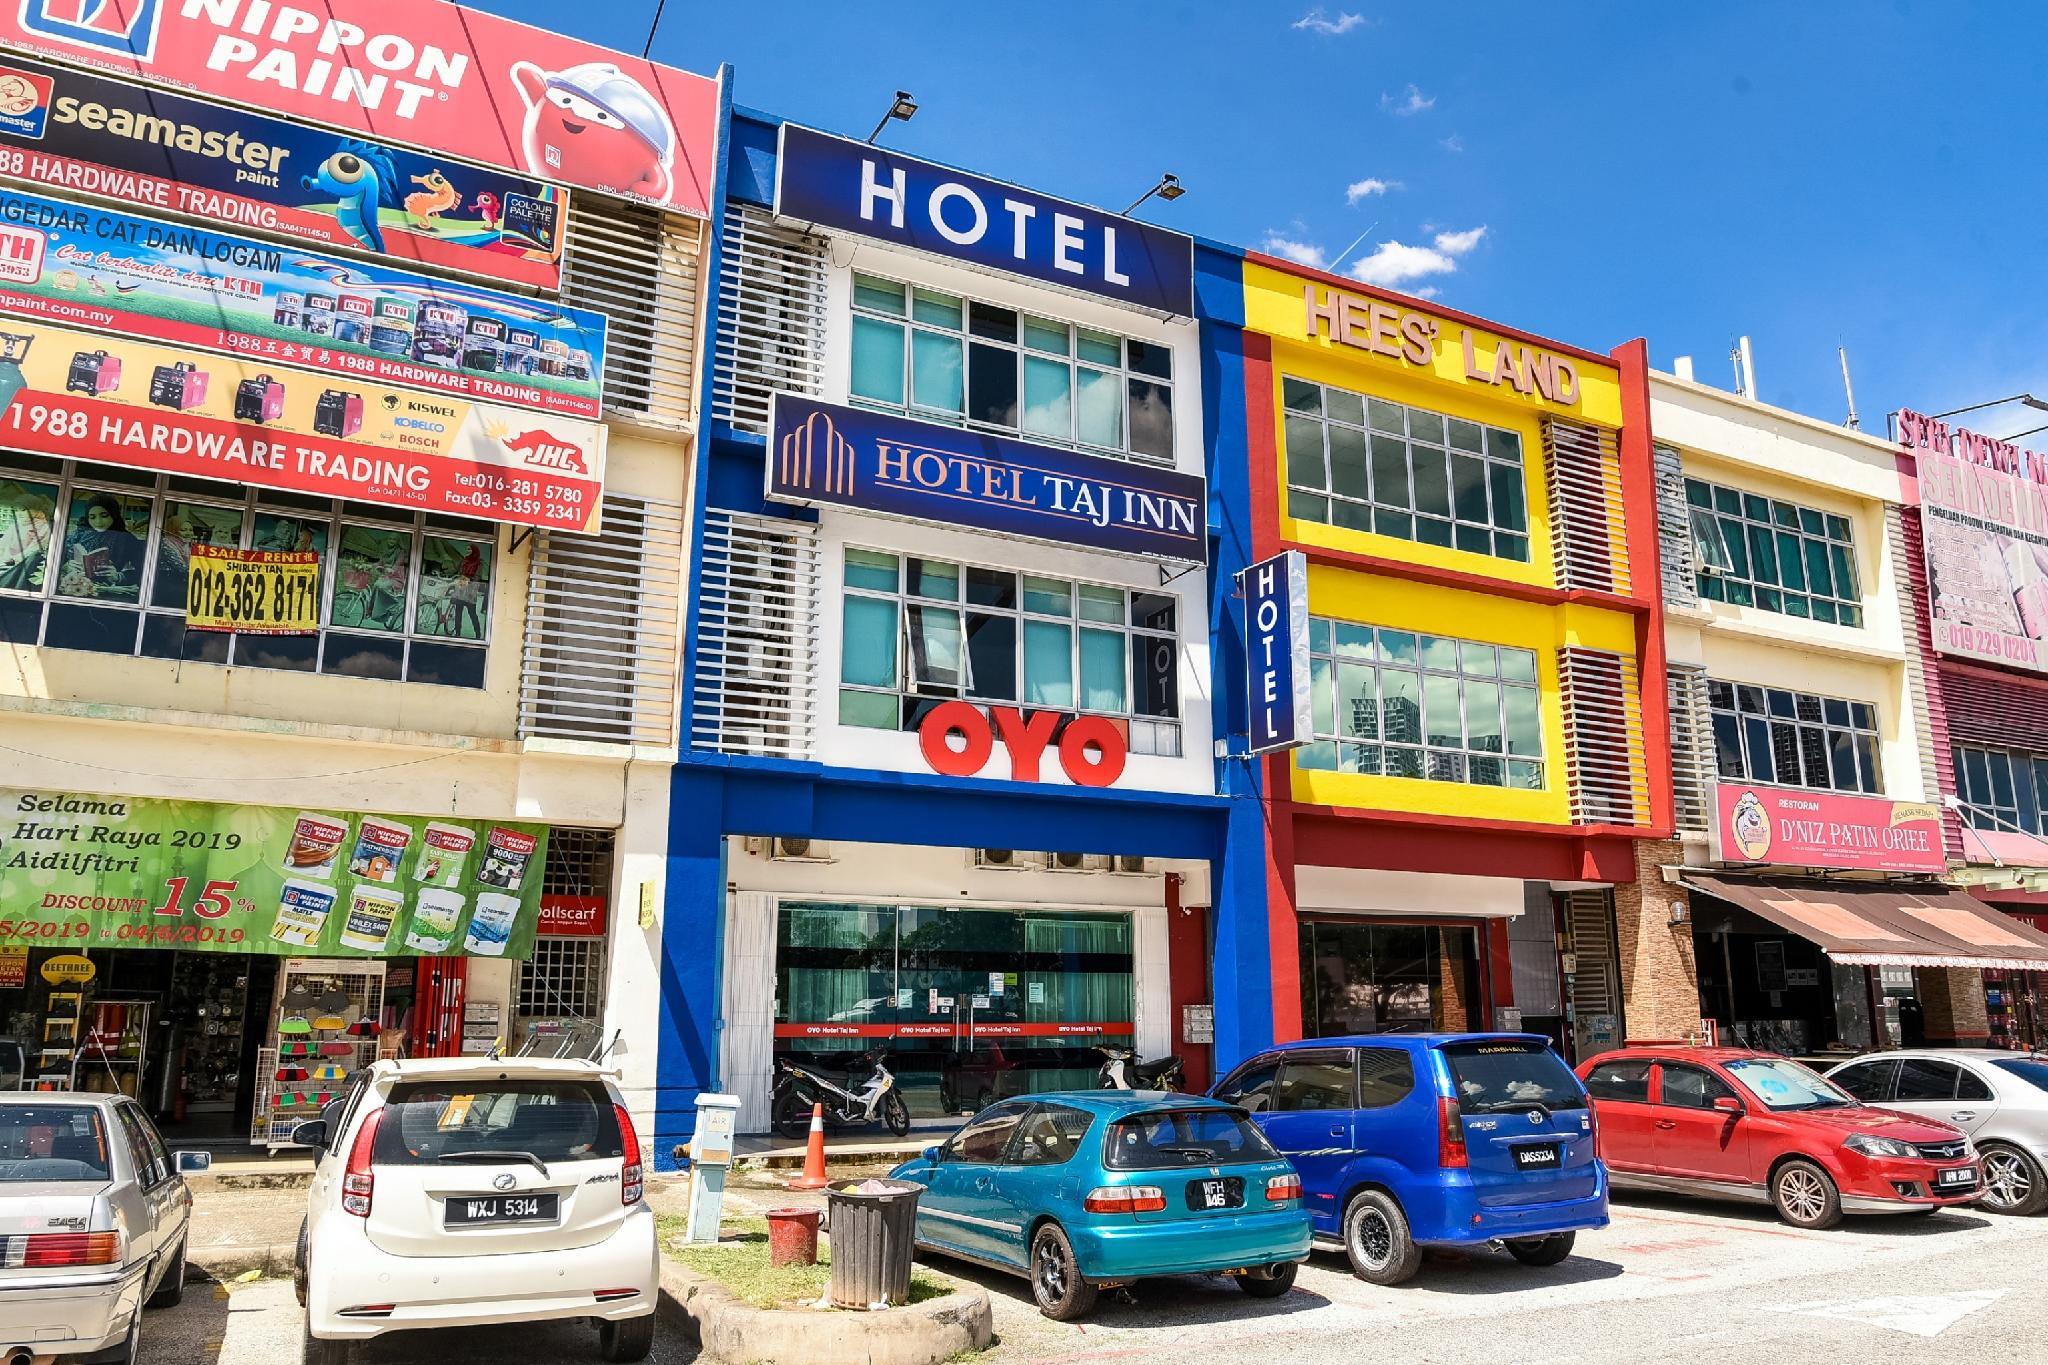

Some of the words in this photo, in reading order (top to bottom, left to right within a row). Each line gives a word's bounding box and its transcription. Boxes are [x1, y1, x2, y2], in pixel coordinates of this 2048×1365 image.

[181, 0, 469, 88] NIPPON
[36, 45, 90, 65] HARDWARE
[92, 58, 134, 75] TRADING
[206, 34, 434, 119] PAINT
[53, 96, 290, 173] seamaster
[31, 155, 171, 206] HARDWARE
[177, 187, 277, 228] TRADING
[235, 169, 279, 189] paint
[509, 206, 552, 223] PALETTE
[510, 199, 552, 214] COLOUR
[0, 196, 89, 235] GEDAR
[96, 217, 142, 244] CAT
[146, 226, 195, 256] DAN
[201, 238, 282, 273] LOGAM
[859, 159, 1131, 287] HOTEL
[56, 244, 93, 261] Cat
[223, 276, 262, 296] KTH
[338, 355, 375, 373] 1988
[380, 363, 468, 390] HARDWARE
[474, 380, 541, 403] TRADING
[1461, 329, 1581, 407] LAND
[408, 401, 457, 418] KISWEL
[393, 416, 445, 433] KOBELCO
[1899, 408, 1953, 457] SERI
[10, 402, 88, 439] 1988
[100, 415, 287, 470] HARDWARE
[295, 447, 431, 492] TRADING
[400, 433, 440, 449] BOSCH
[454, 472, 539, 497] Tel:016-281
[544, 484, 583, 504] 5780
[874, 443, 1036, 506] HOTEL
[1043, 475, 1110, 527] TAJ
[1123, 492, 1198, 535] INN
[445, 490, 498, 509] Fax:03-
[503, 497, 541, 515] 3359
[545, 503, 582, 522] 2341
[209, 546, 246, 560] SALE
[263, 552, 301, 562] RENT
[226, 561, 263, 574] SHIRLEY
[264, 564, 283, 575] TAN
[190, 567, 266, 621] 012-362
[273, 573, 316, 622] 8171
[1257, 563, 1279, 739] HOTEL
[1949, 623, 1974, 651] 019
[1976, 629, 2001, 657] 229
[919, 700, 1127, 788] OYO
[17, 794, 127, 817] Selama
[1778, 798, 1819, 812] RESTORAN
[12, 822, 80, 842] Hari
[87, 825, 161, 850] Raya
[170, 830, 243, 850] 2019
[1781, 818, 1827, 845] D'NIZ
[1830, 822, 1879, 849] PATIN
[1882, 827, 1931, 852] ORIEE
[7, 851, 140, 876] Aidilfitri
[493, 848, 513, 860] 9000
[41, 892, 148, 913] DISCOUNT
[116, 924, 245, 944] 04/6/2019
[44, 963, 90, 972] BEETHREE
[822, 1026, 839, 1034] Hotel
[1478, 1046, 1528, 1054] MARSHALL
[1202, 1181, 1224, 1195] WFH
[467, 1200, 497, 1218] WXJ
[505, 1198, 539, 1216] 5314
